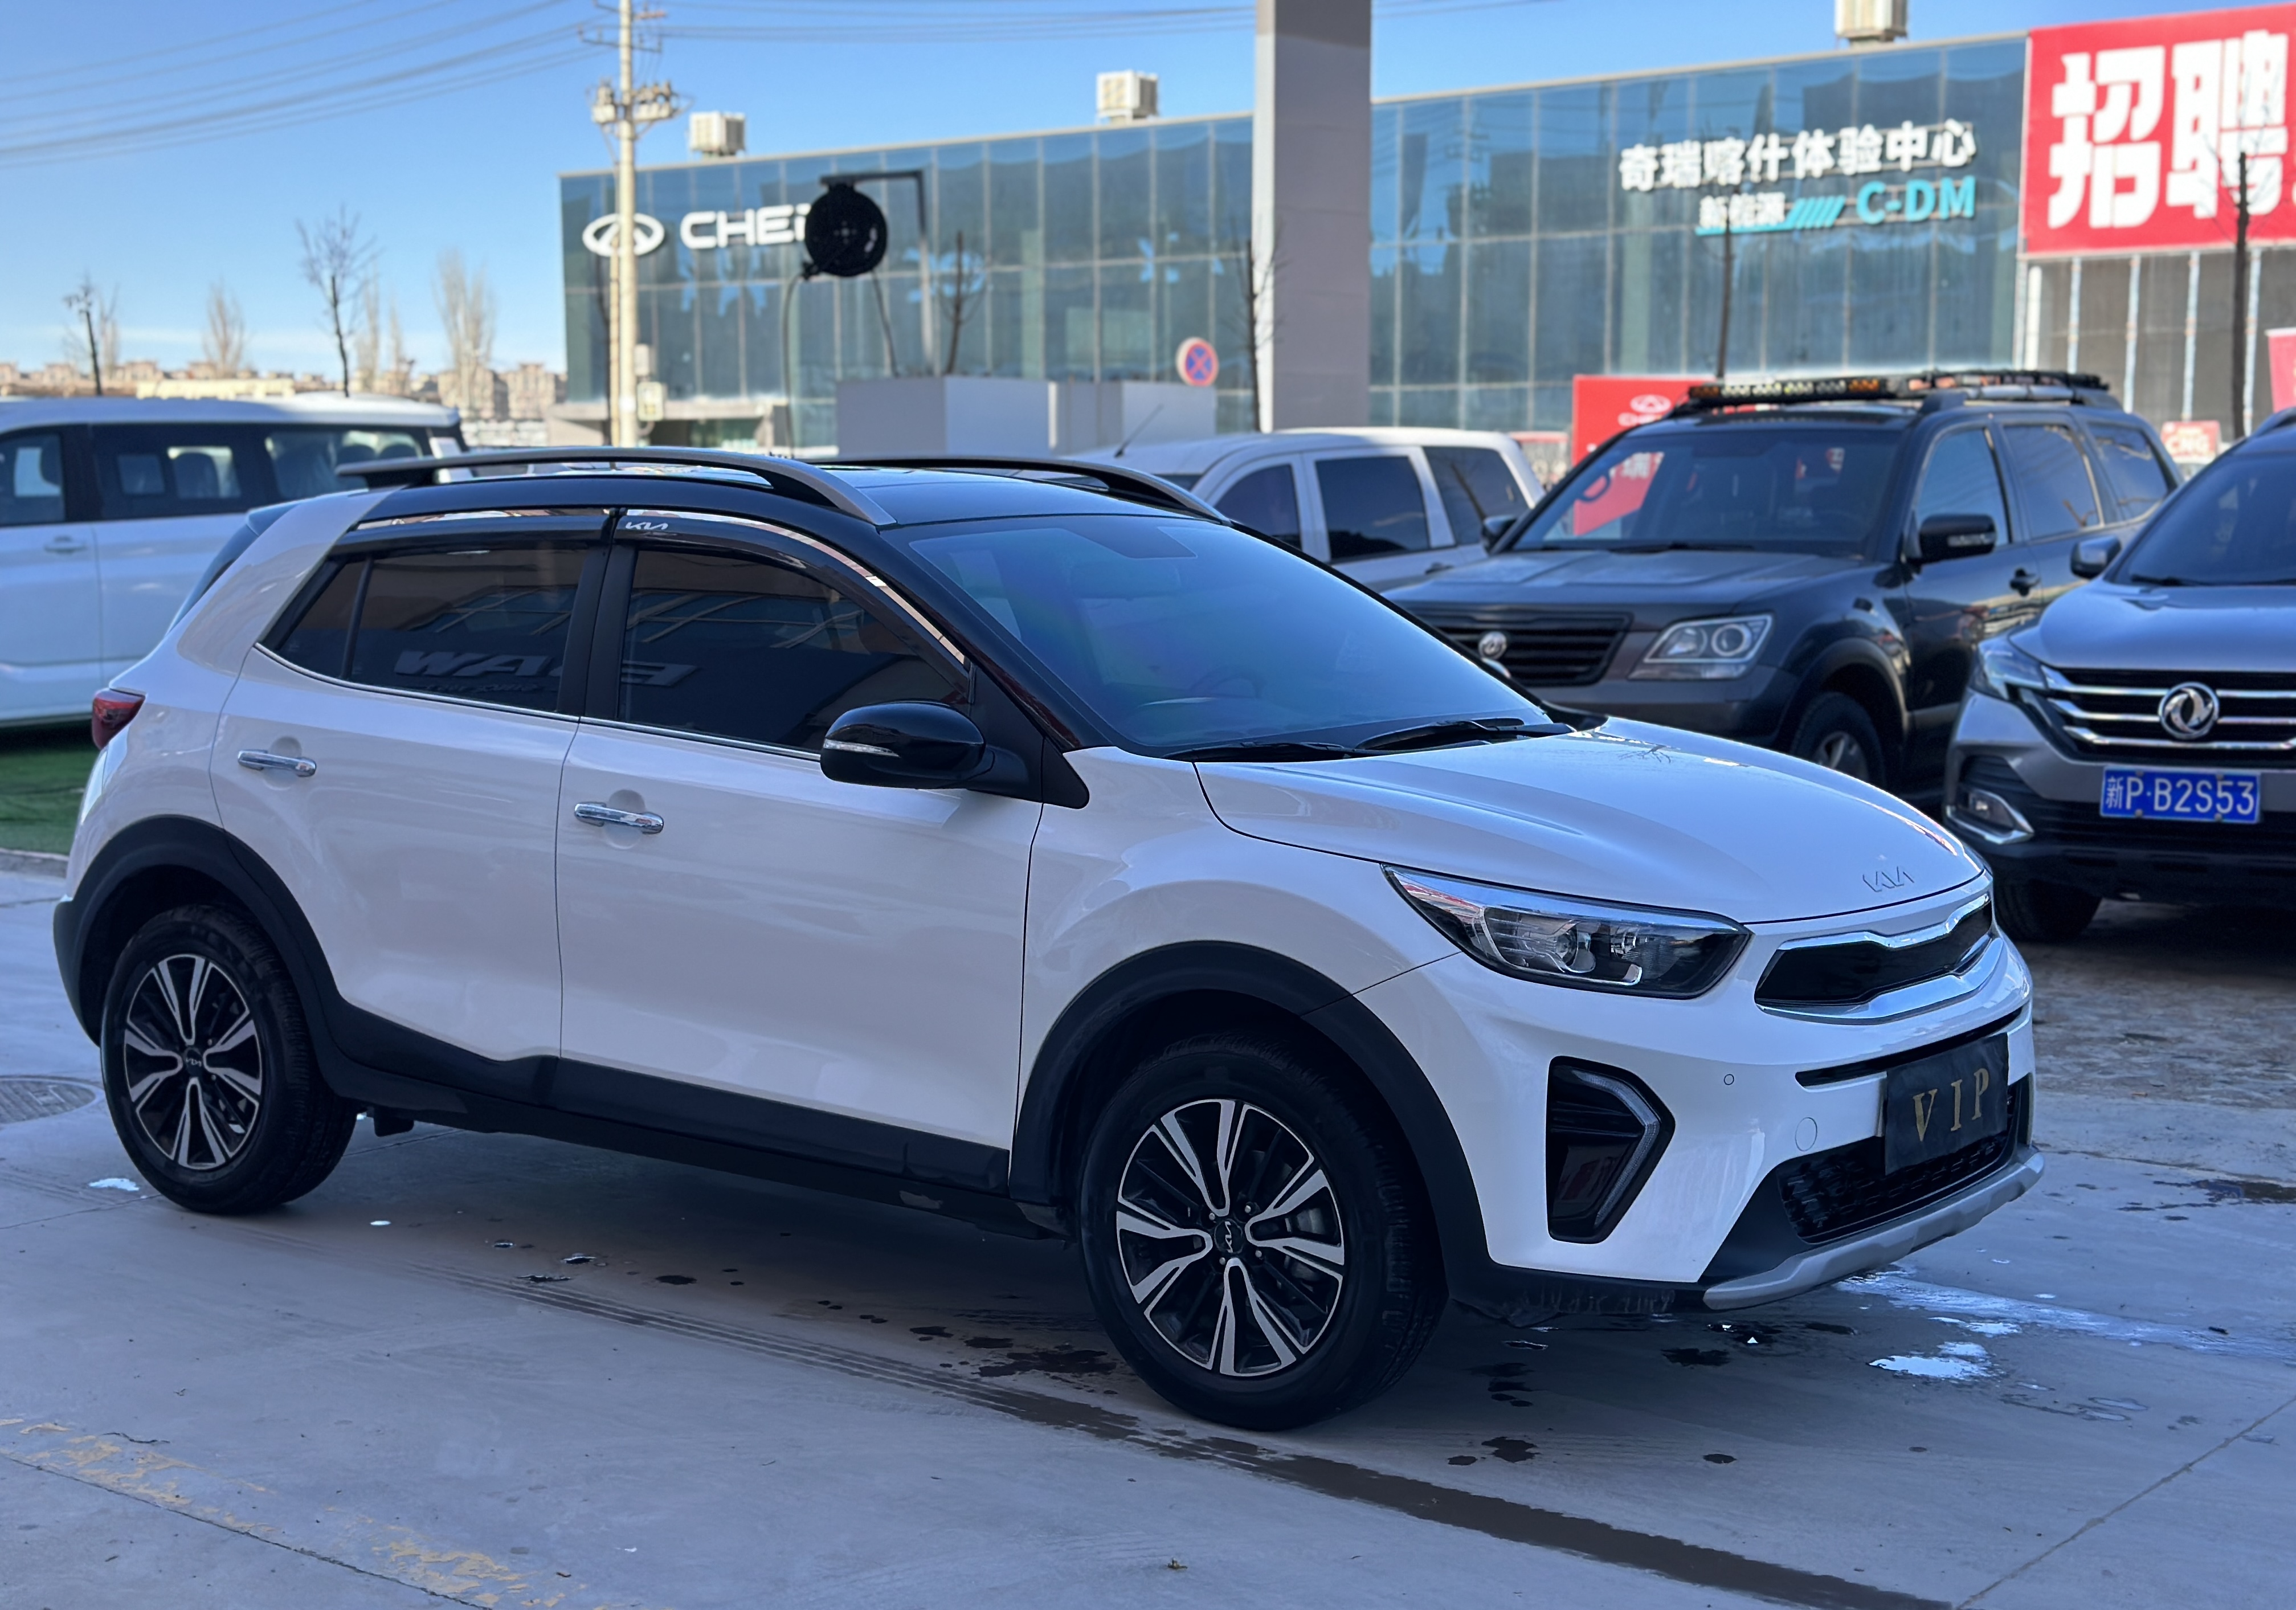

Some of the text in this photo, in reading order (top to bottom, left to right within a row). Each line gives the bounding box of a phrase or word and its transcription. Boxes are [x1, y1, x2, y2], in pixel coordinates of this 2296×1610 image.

[1619, 118, 1976, 191] 奇瑞喀什体验中心
[2048, 30, 2289, 230] 招聘
[1856, 175, 1976, 224] C-DM
[1913, 1068, 1989, 1142] VIP
